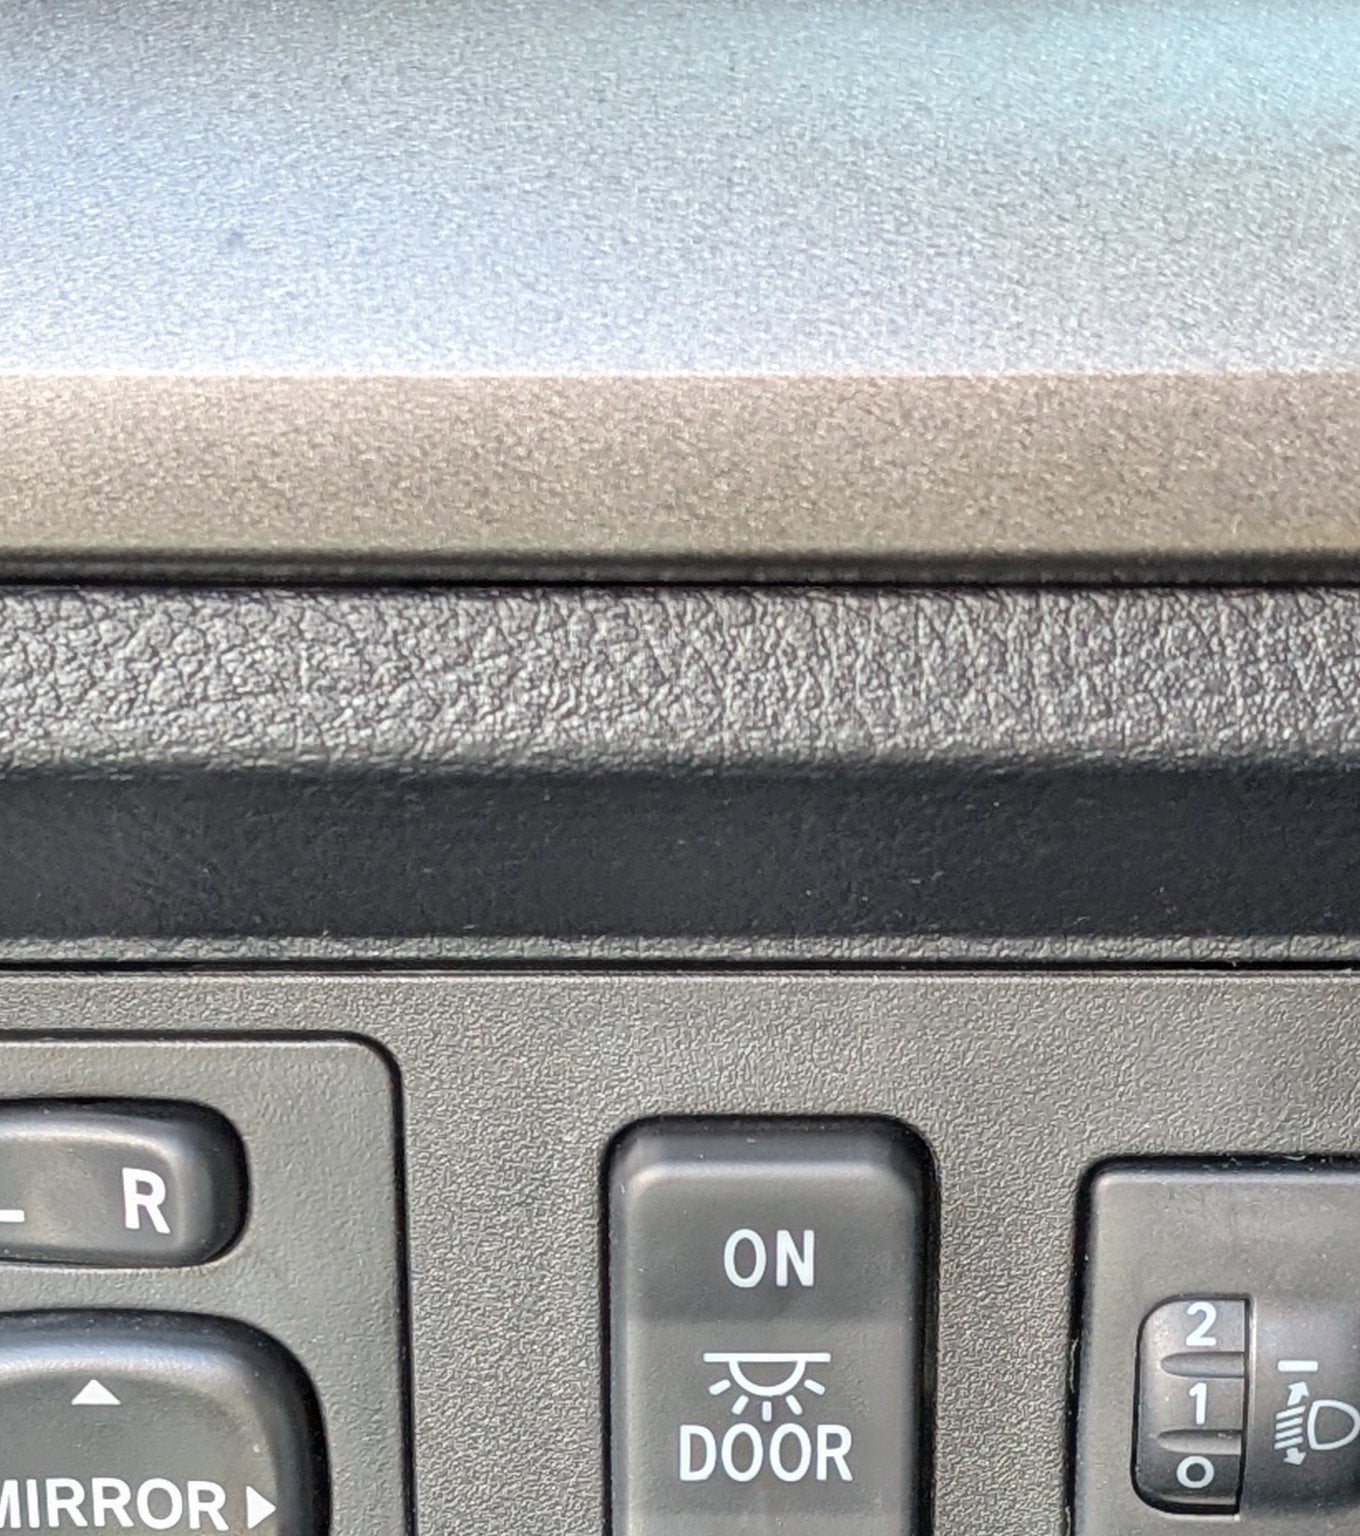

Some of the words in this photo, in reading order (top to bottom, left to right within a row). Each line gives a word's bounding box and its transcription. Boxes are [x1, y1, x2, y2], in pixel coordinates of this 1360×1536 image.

[122, 1168, 171, 1234] R
[723, 1228, 815, 1288] ON
[1186, 1302, 1218, 1348] 2
[1189, 1382, 1207, 1425] 1
[679, 1423, 852, 1482] DOOR
